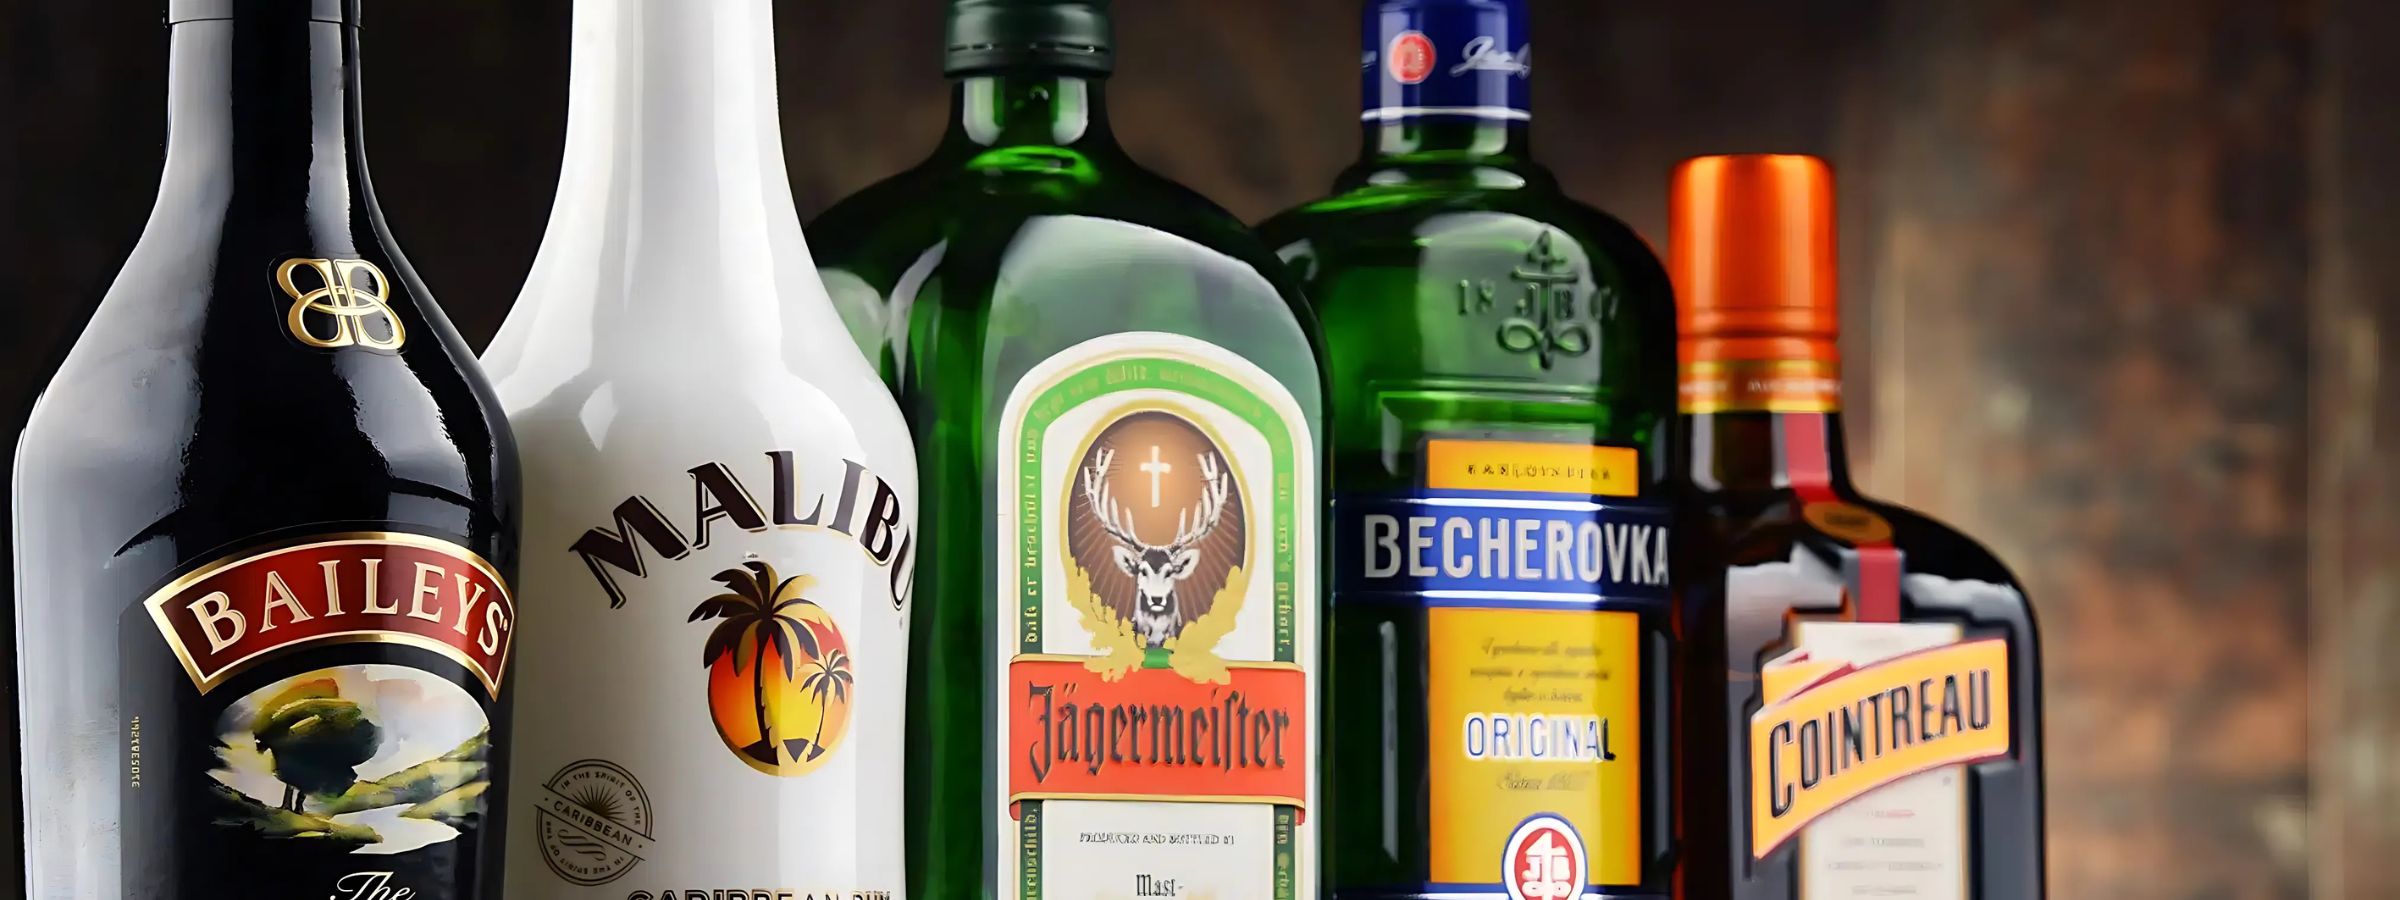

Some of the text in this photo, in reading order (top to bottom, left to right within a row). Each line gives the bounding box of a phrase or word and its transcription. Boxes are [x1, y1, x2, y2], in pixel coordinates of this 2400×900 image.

[1364, 514, 1671, 588] BECHEROVKA
[186, 558, 504, 656] BAILEYS
[1466, 714, 1617, 763] ORIGINAL
[1769, 668, 1992, 819] COINTREAU
[553, 800, 632, 846] CARIBBEAN
